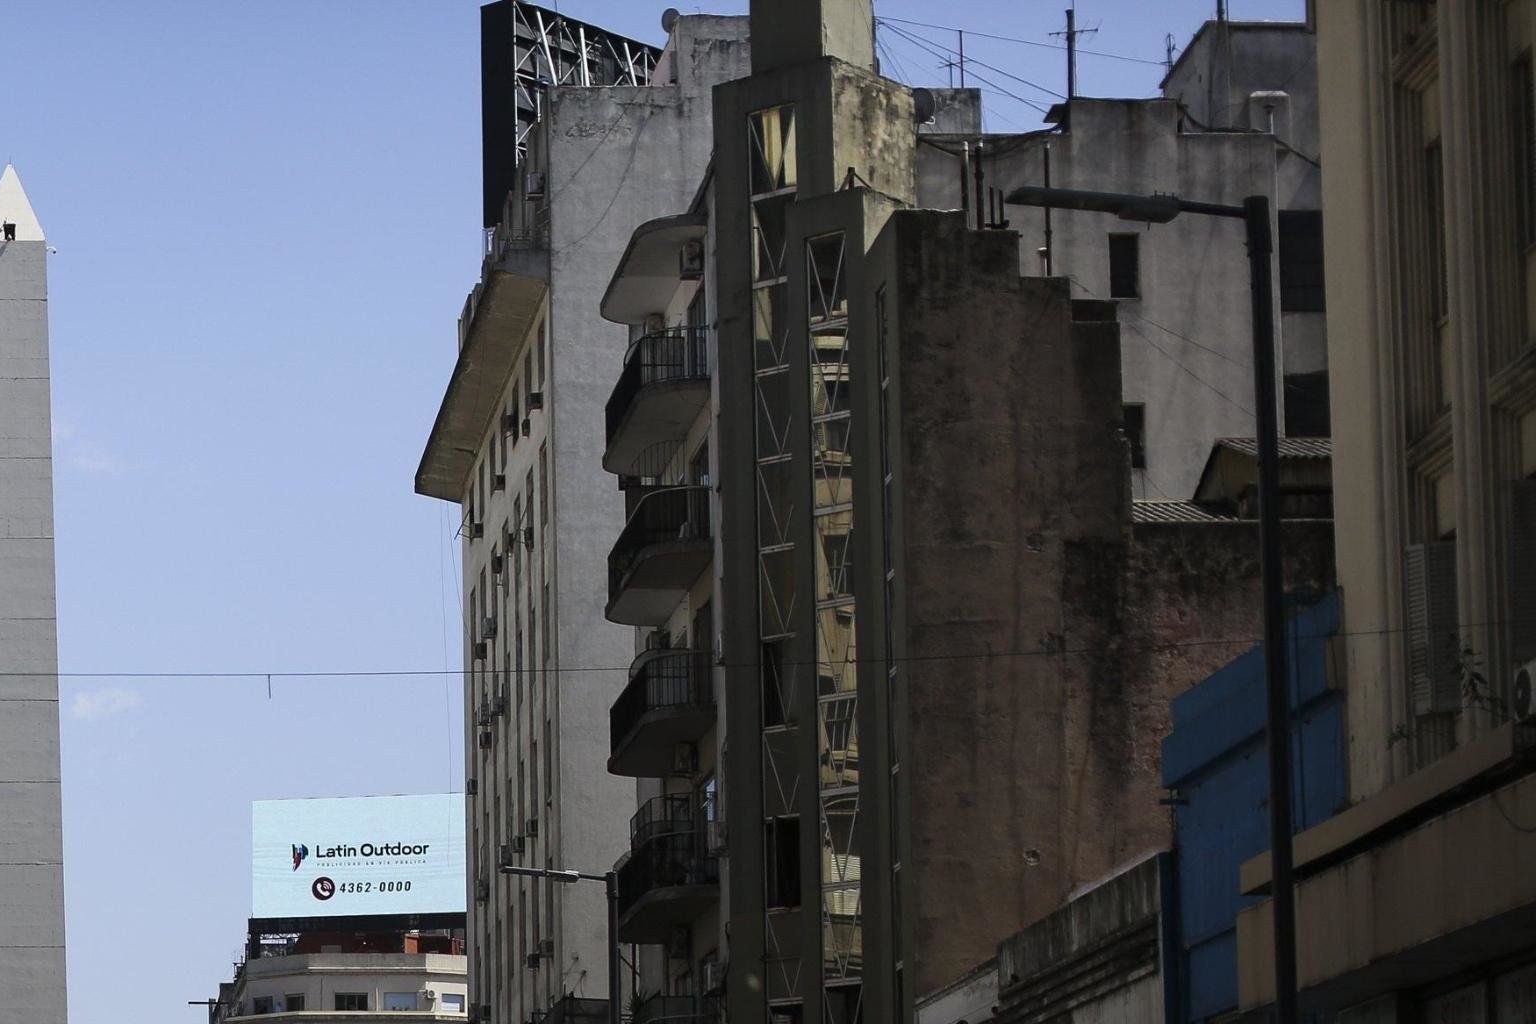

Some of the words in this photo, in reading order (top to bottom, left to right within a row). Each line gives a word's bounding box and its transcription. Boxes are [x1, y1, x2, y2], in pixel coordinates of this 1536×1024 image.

[316, 844, 357, 858] Latin
[360, 842, 429, 857] Outdoor
[339, 881, 412, 894] 4362-0000
